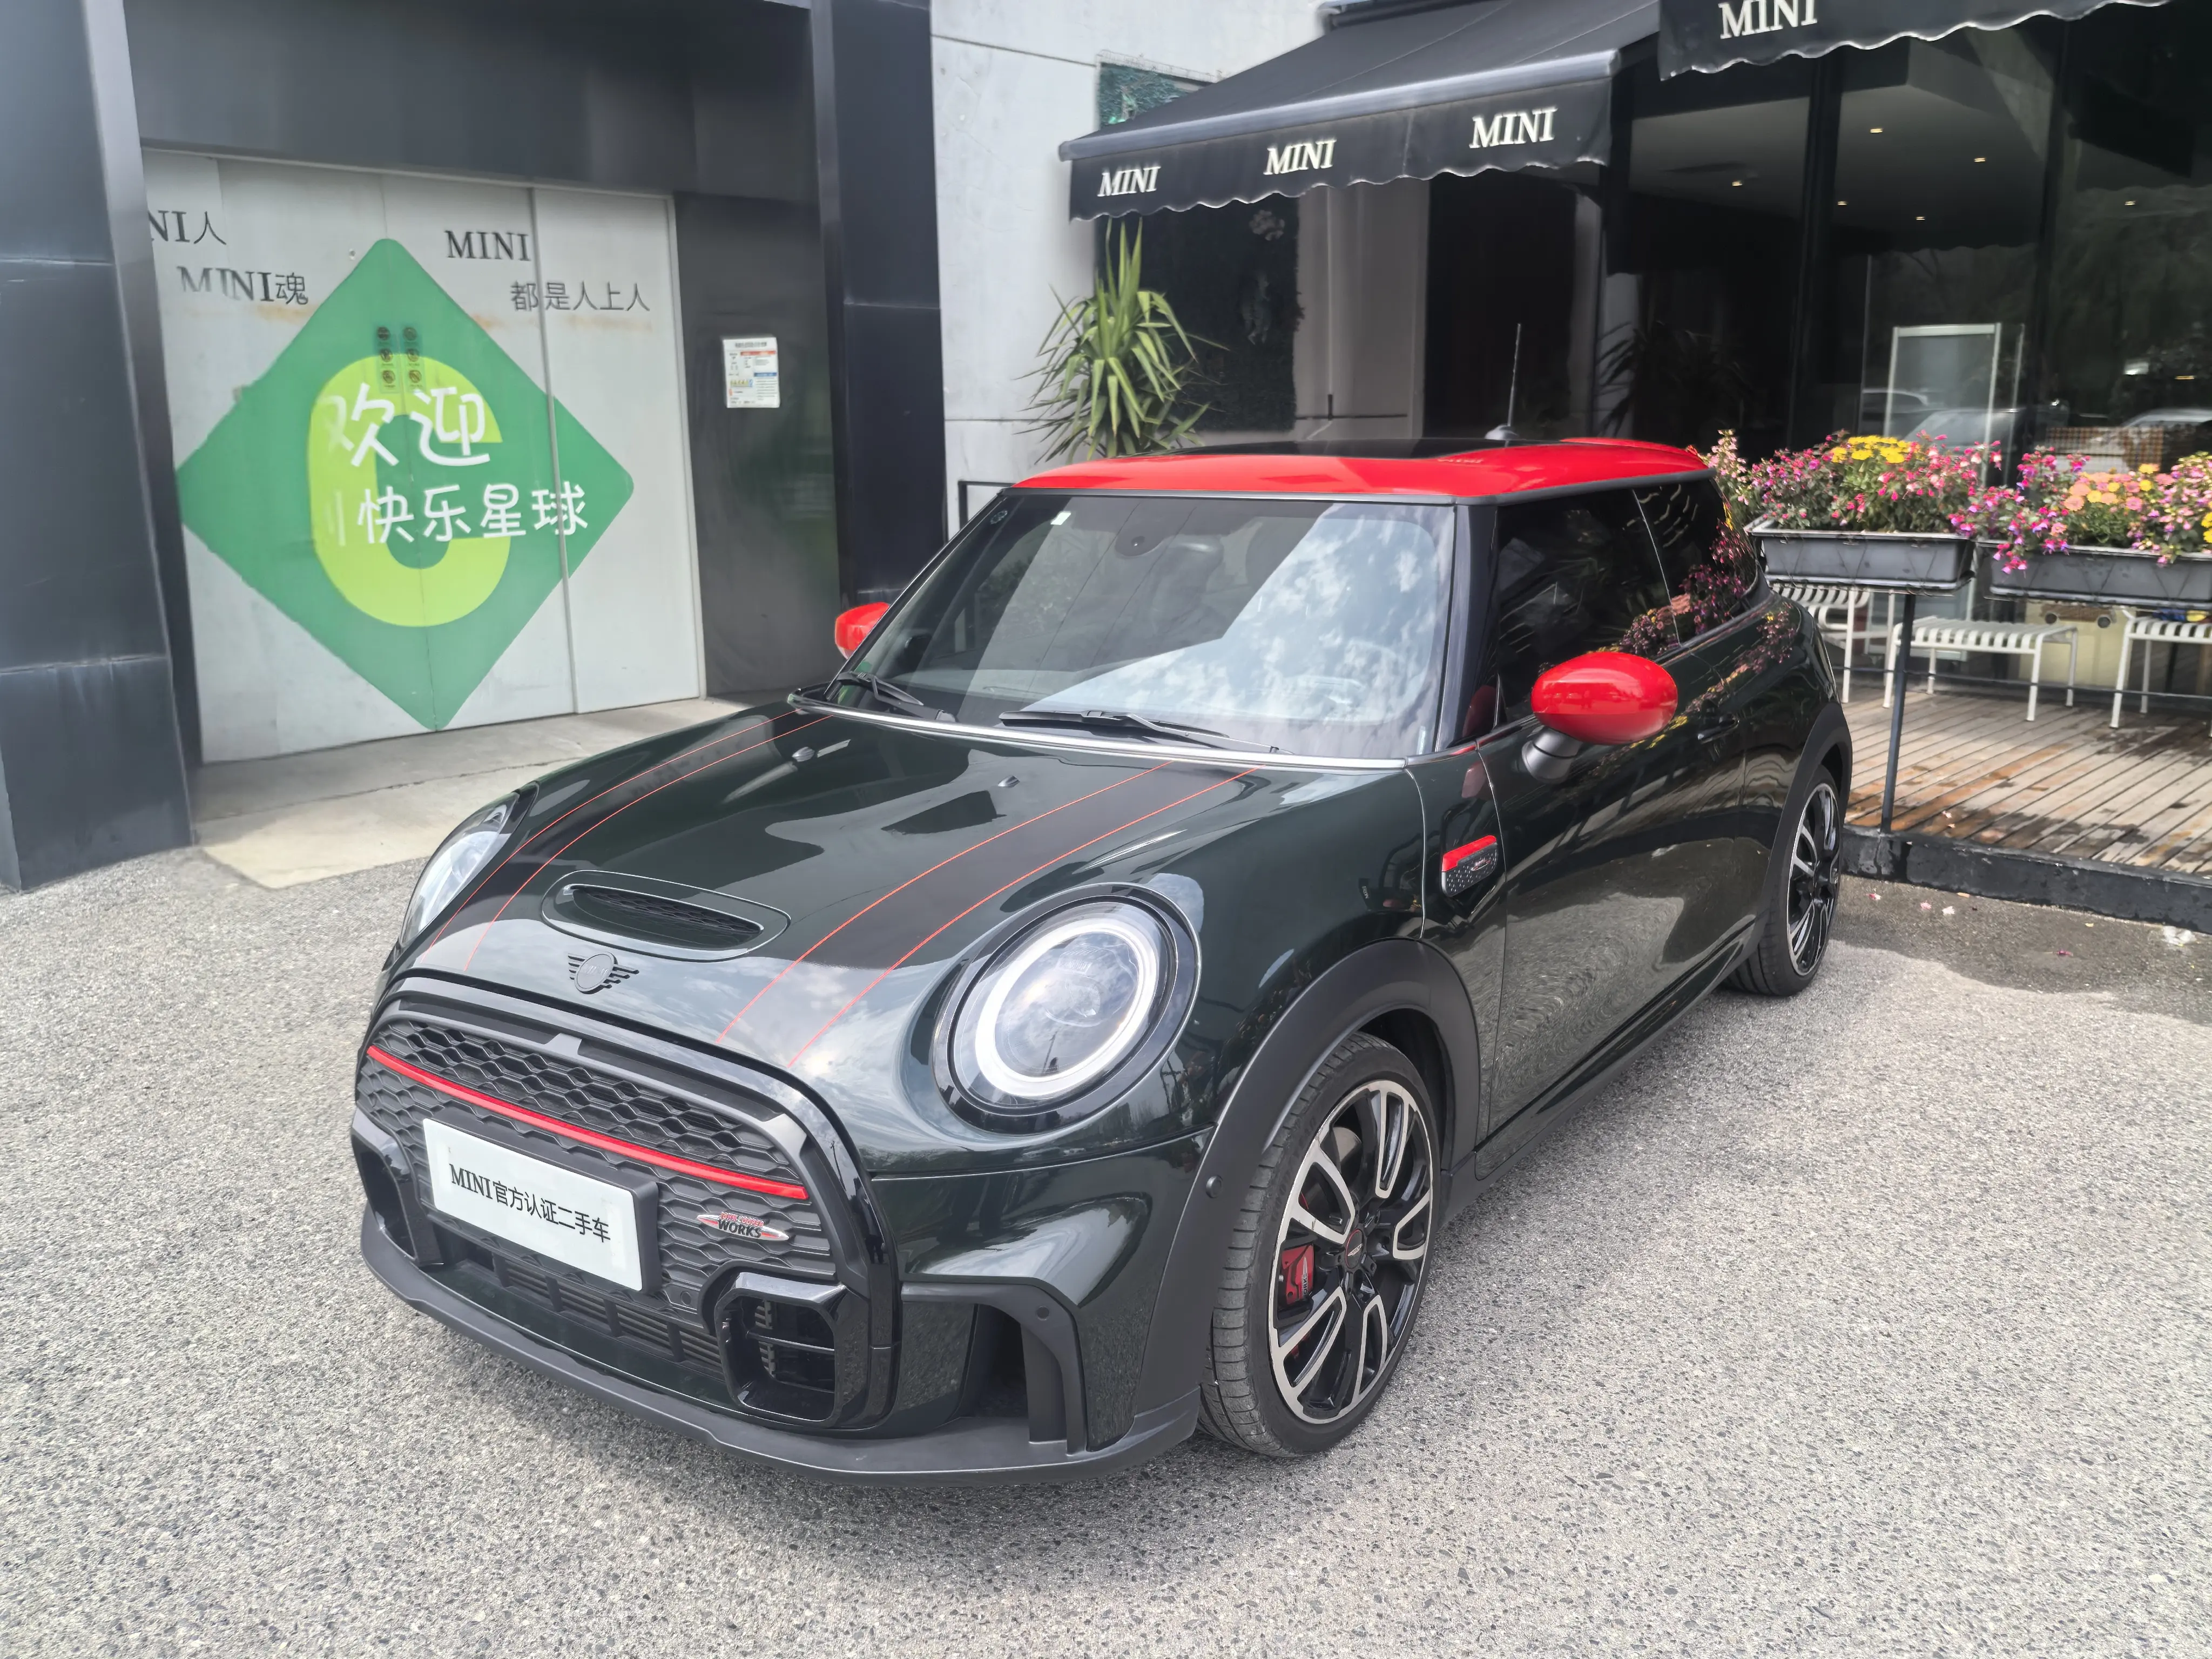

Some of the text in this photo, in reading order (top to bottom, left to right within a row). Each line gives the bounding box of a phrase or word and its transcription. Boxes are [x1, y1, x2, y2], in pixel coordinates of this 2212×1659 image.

[1718, 0, 1818, 39] MINI
[1469, 106, 1559, 149] MINI
[1263, 138, 1337, 176] MINI
[1097, 165, 1161, 197] MINI
[444, 230, 532, 262] MINI
[176, 265, 308, 305] MINI魂
[510, 280, 650, 312] 都是人上人
[318, 382, 491, 467] 欢迎
[449, 1163, 611, 1243] MINI官方认证二手车
[717, 1219, 763, 1238] WORKS
